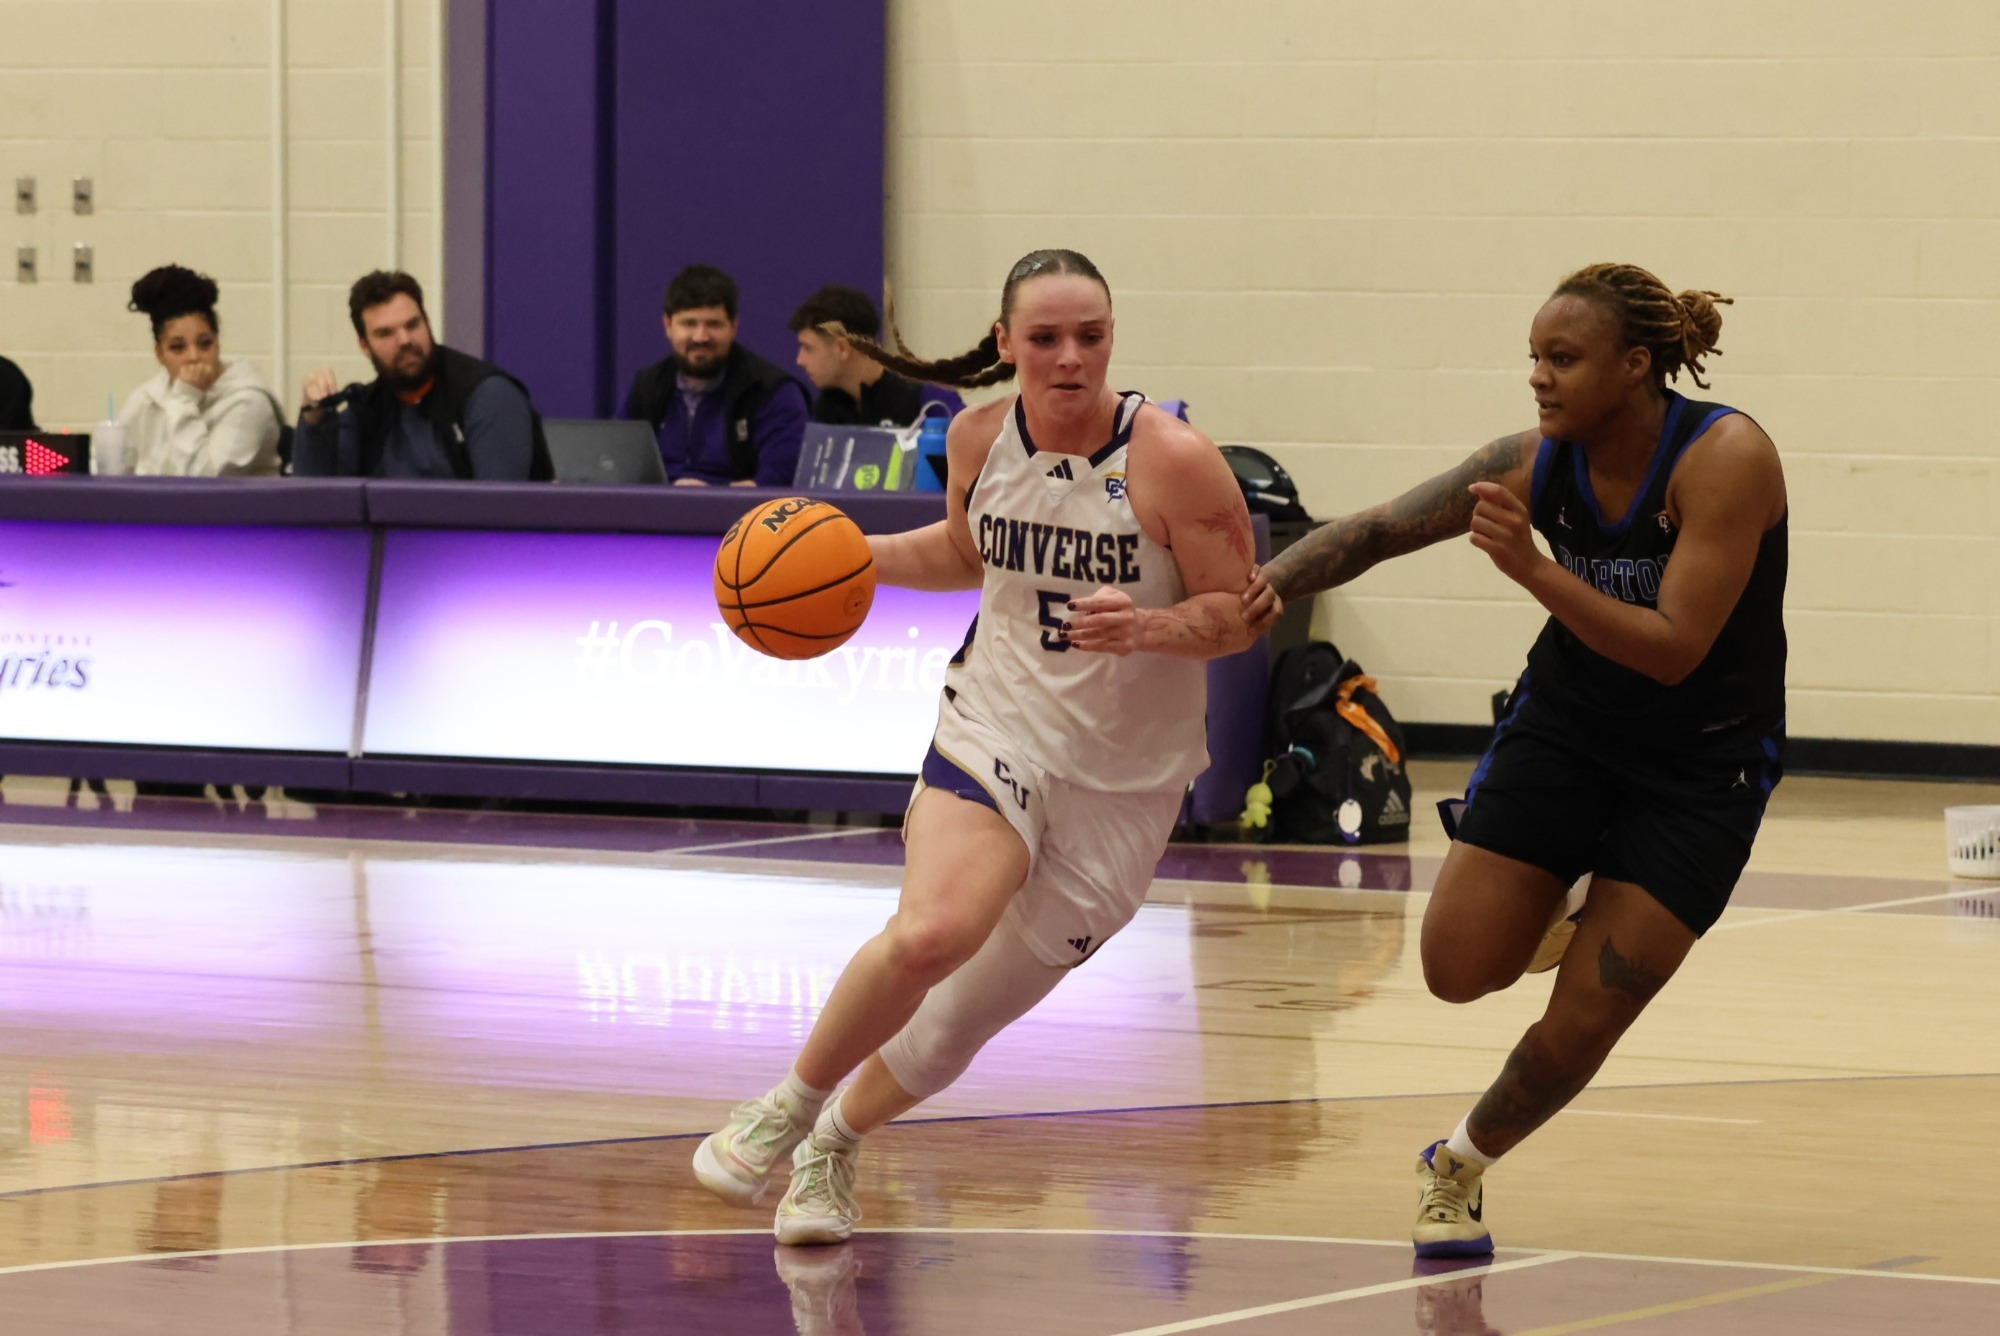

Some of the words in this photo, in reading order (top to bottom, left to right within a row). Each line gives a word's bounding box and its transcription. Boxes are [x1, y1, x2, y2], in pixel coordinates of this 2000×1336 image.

[761, 498, 817, 533] NCA
[979, 513, 1141, 584] CONVERSE
[1559, 545, 1672, 602] ARTO
[1036, 590, 1073, 652] 5
